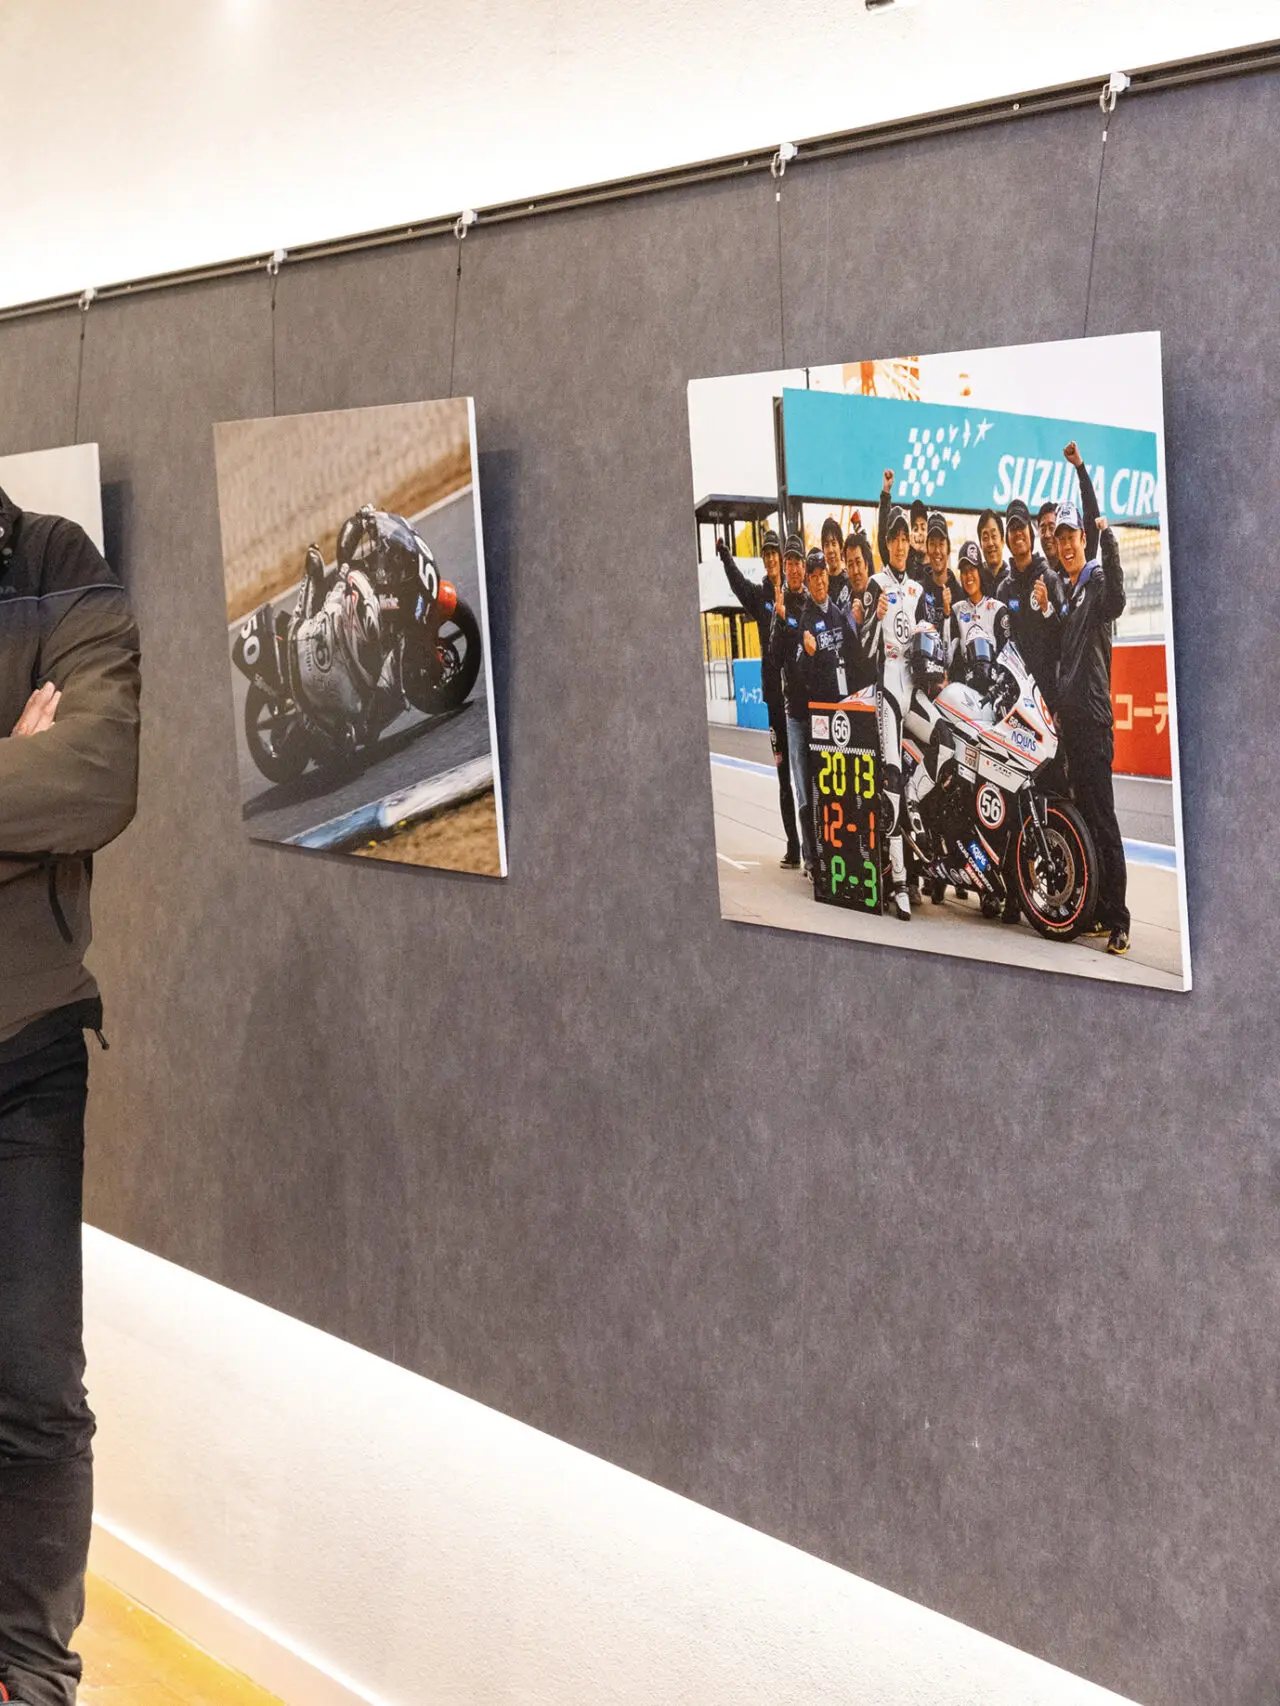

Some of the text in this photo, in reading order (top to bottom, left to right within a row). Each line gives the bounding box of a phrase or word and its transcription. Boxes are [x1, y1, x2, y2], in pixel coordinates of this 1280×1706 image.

[240, 614, 260, 664] 50
[896, 618, 909, 640] 56
[835, 719, 849, 740] 56
[818, 751, 875, 799] 2013
[823, 802, 875, 849] 12-1
[981, 793, 1001, 821] 56
[831, 855, 877, 907] P-3
